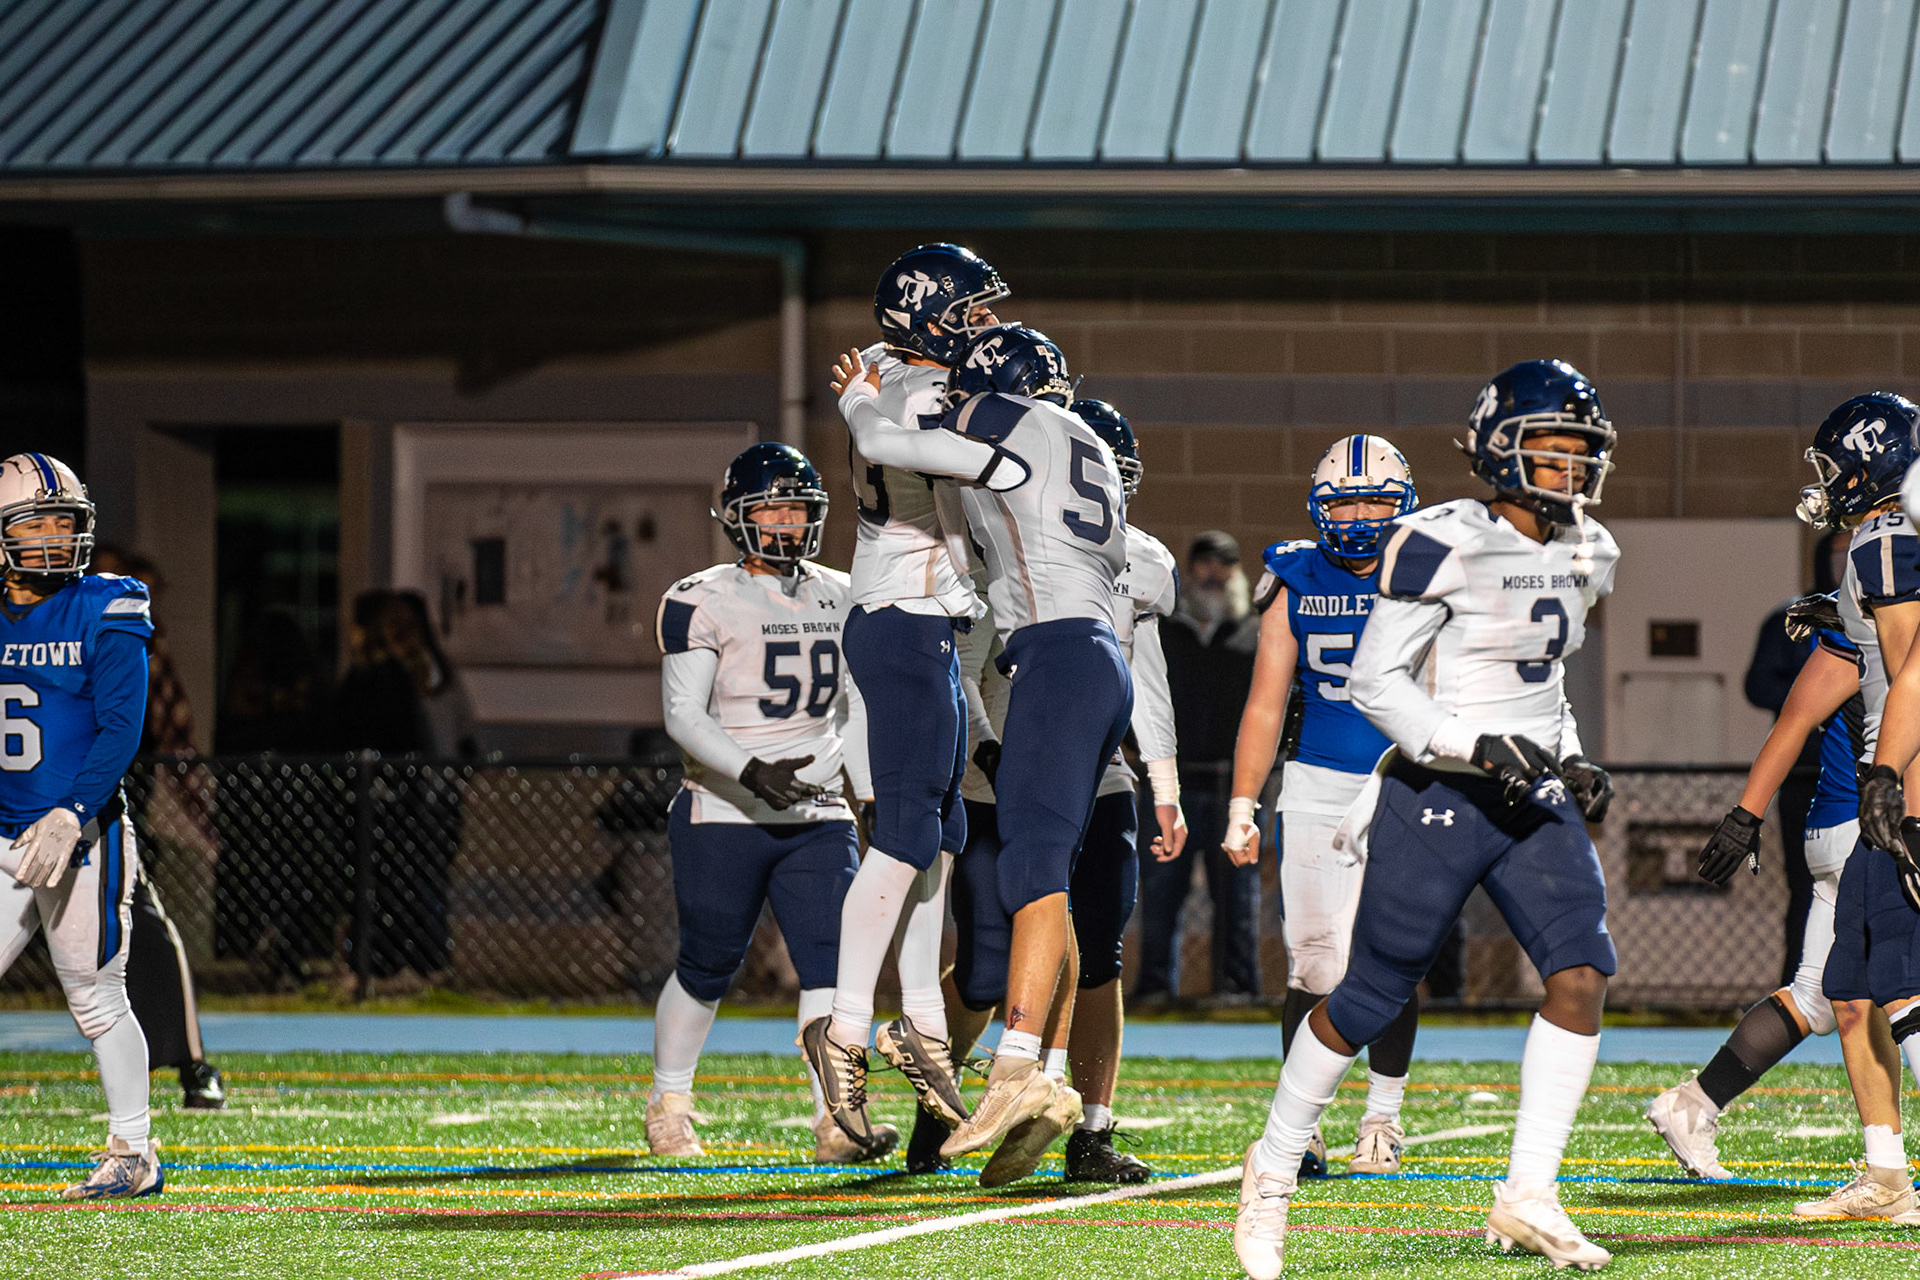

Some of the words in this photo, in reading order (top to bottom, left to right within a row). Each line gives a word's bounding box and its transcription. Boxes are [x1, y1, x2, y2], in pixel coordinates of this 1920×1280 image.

[1062, 436, 1127, 546] 5
[1869, 510, 1906, 533] 15
[1502, 575, 1545, 591] MOSES
[1551, 574, 1590, 589] BROWN
[761, 623, 799, 636] MOSES
[803, 621, 841, 634] BROWN
[1515, 596, 1570, 684] 3
[758, 639, 840, 719] 58
[0, 681, 44, 773] 6
